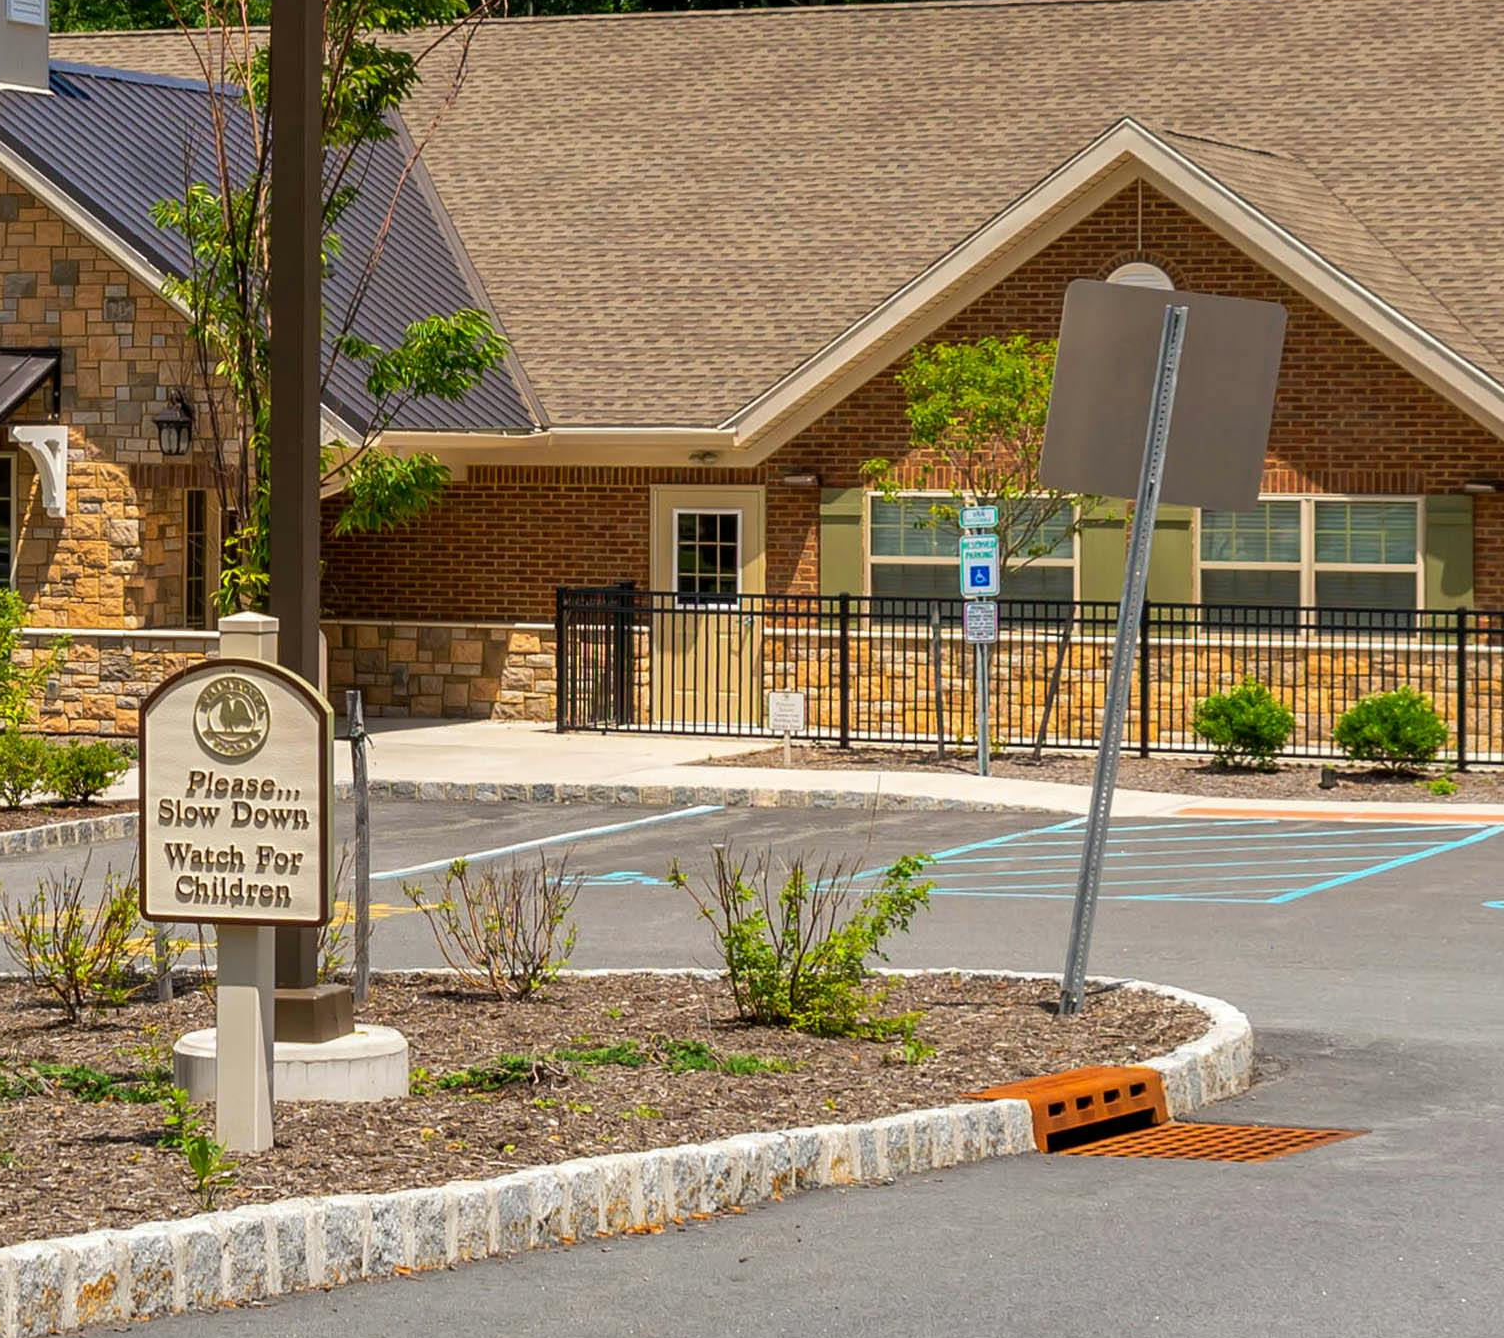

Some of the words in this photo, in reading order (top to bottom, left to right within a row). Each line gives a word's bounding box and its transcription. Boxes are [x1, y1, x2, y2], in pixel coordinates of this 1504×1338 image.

[158, 799, 220, 825] Slow
[232, 801, 309, 826] Down
[164, 843, 245, 869] Watch
[256, 846, 304, 870] For
[176, 875, 291, 902] Children
